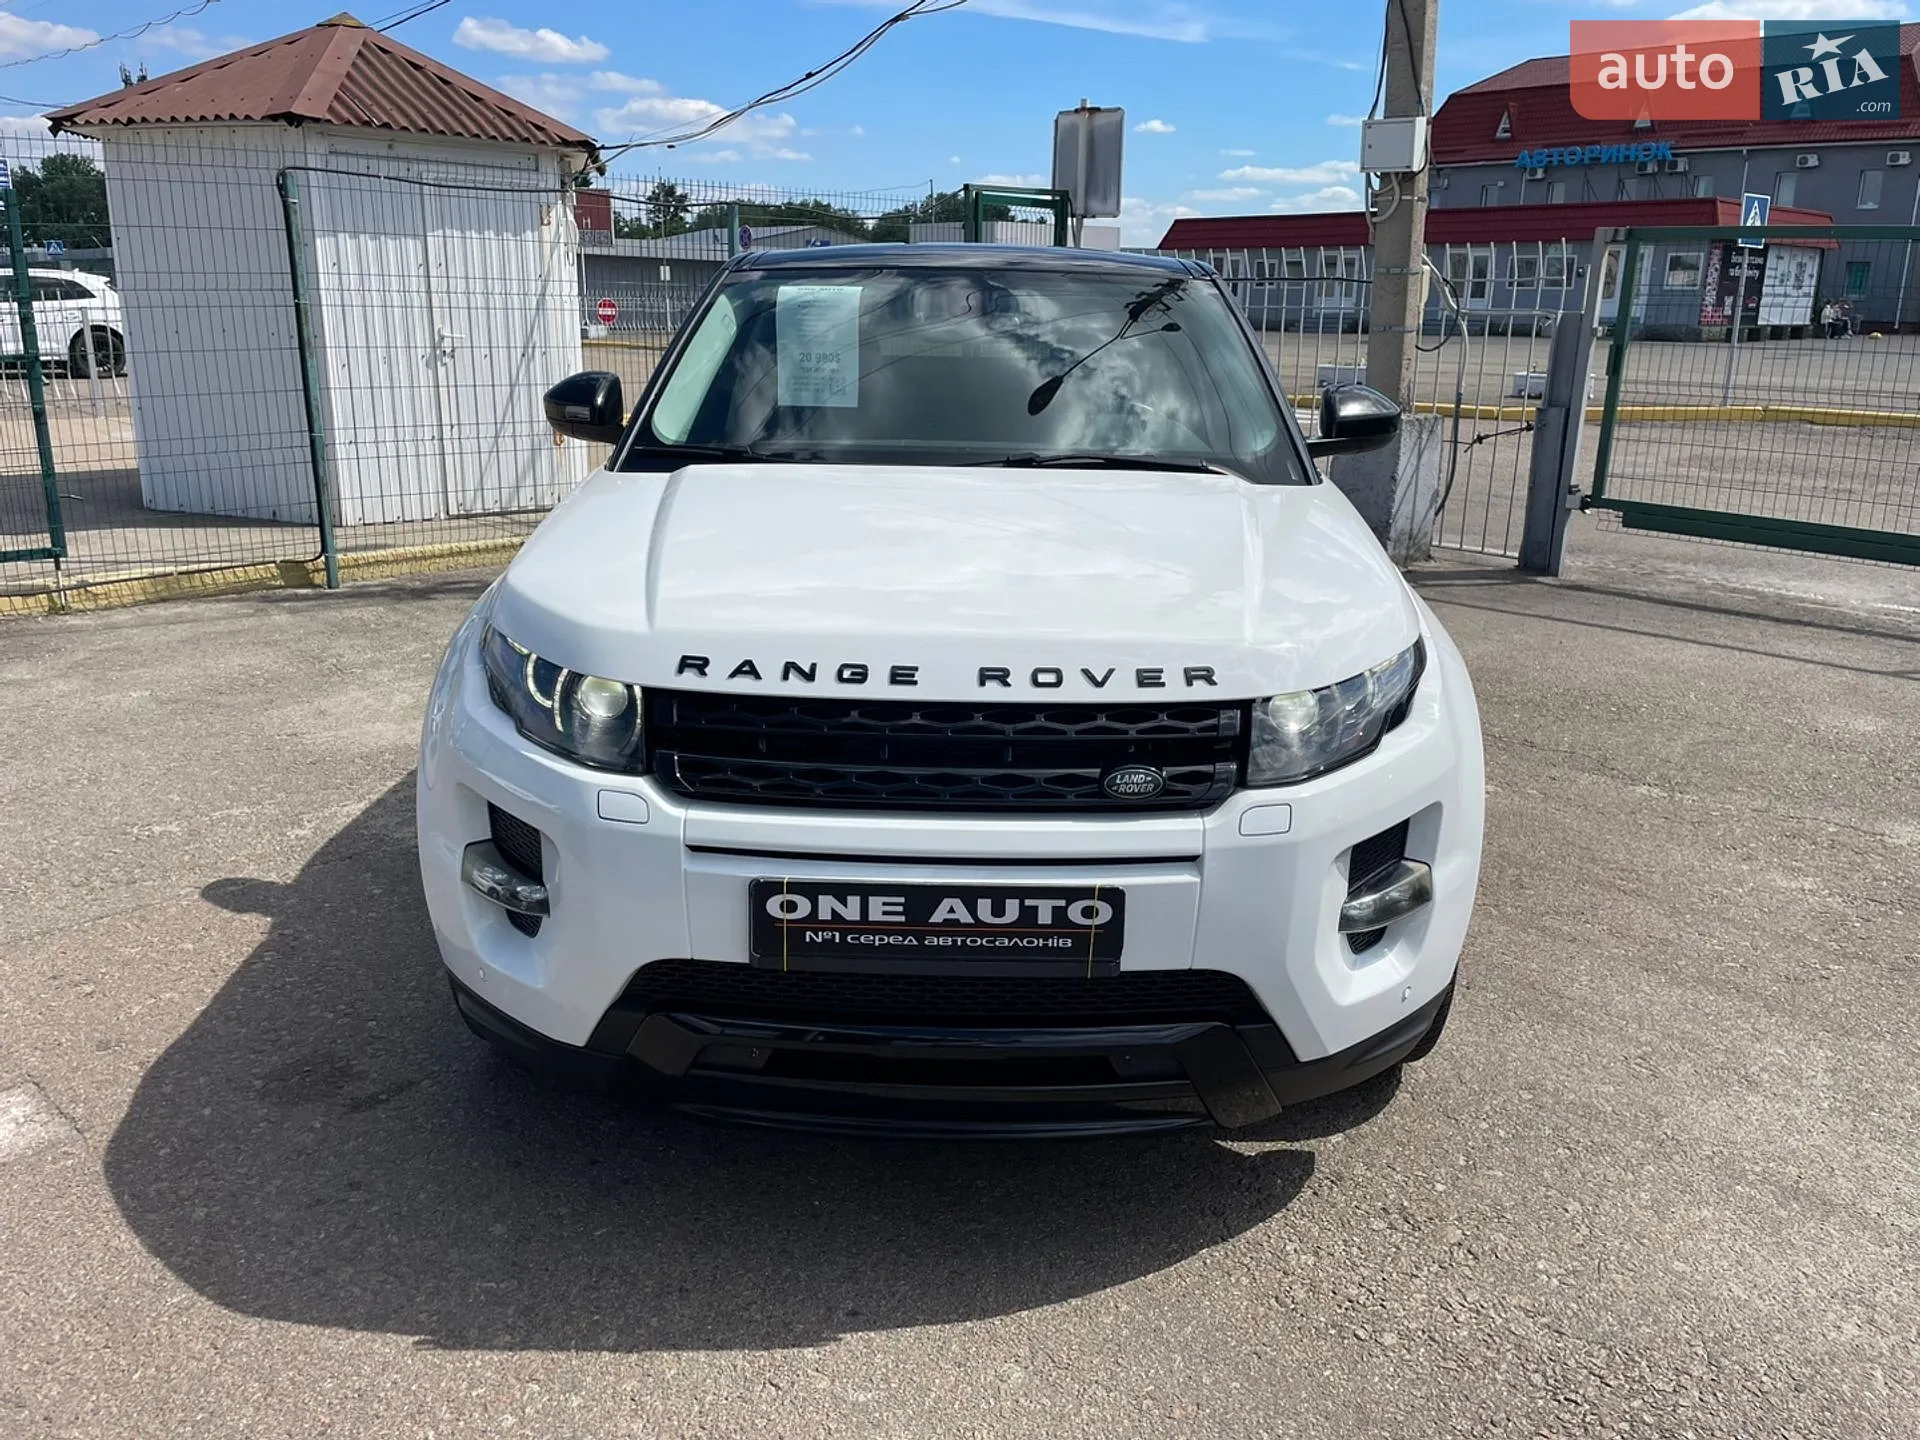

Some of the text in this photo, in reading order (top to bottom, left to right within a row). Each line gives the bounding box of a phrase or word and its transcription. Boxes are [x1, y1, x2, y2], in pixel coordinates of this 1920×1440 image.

[1515, 140, 1675, 168] АВТОРИНОК
[676, 654, 1219, 688] RANGE ROVER
[1118, 783, 1155, 793] ROVER
[766, 893, 1114, 926] ONE AUTO
[846, 932, 919, 947] серед
[925, 934, 1072, 948] автосалонів
